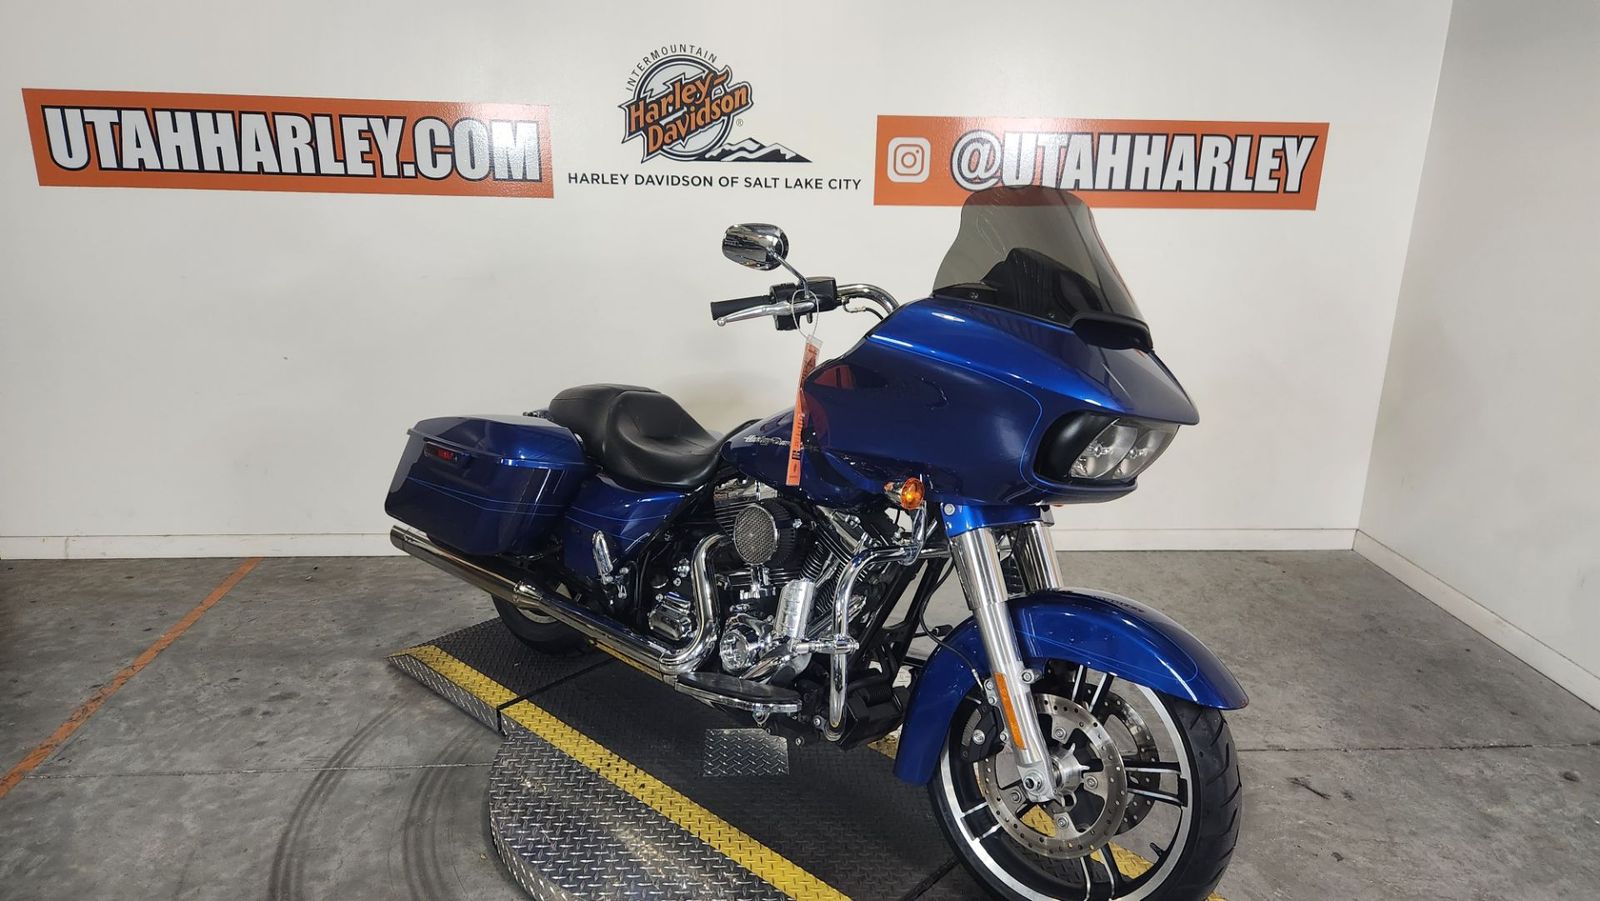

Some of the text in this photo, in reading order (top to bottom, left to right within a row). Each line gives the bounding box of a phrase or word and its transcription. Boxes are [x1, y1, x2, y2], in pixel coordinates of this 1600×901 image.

[626, 43, 718, 92] INTERMOUNTAIN
[629, 68, 730, 133] Harley-
[647, 86, 749, 154] Davidson
[41, 104, 543, 182] UTAHHARLEY.COM
[950, 129, 1318, 193] @UTAHHARLEY
[567, 172, 862, 190] HARLEY DAVIDSON OF SALT LAKE CITY
